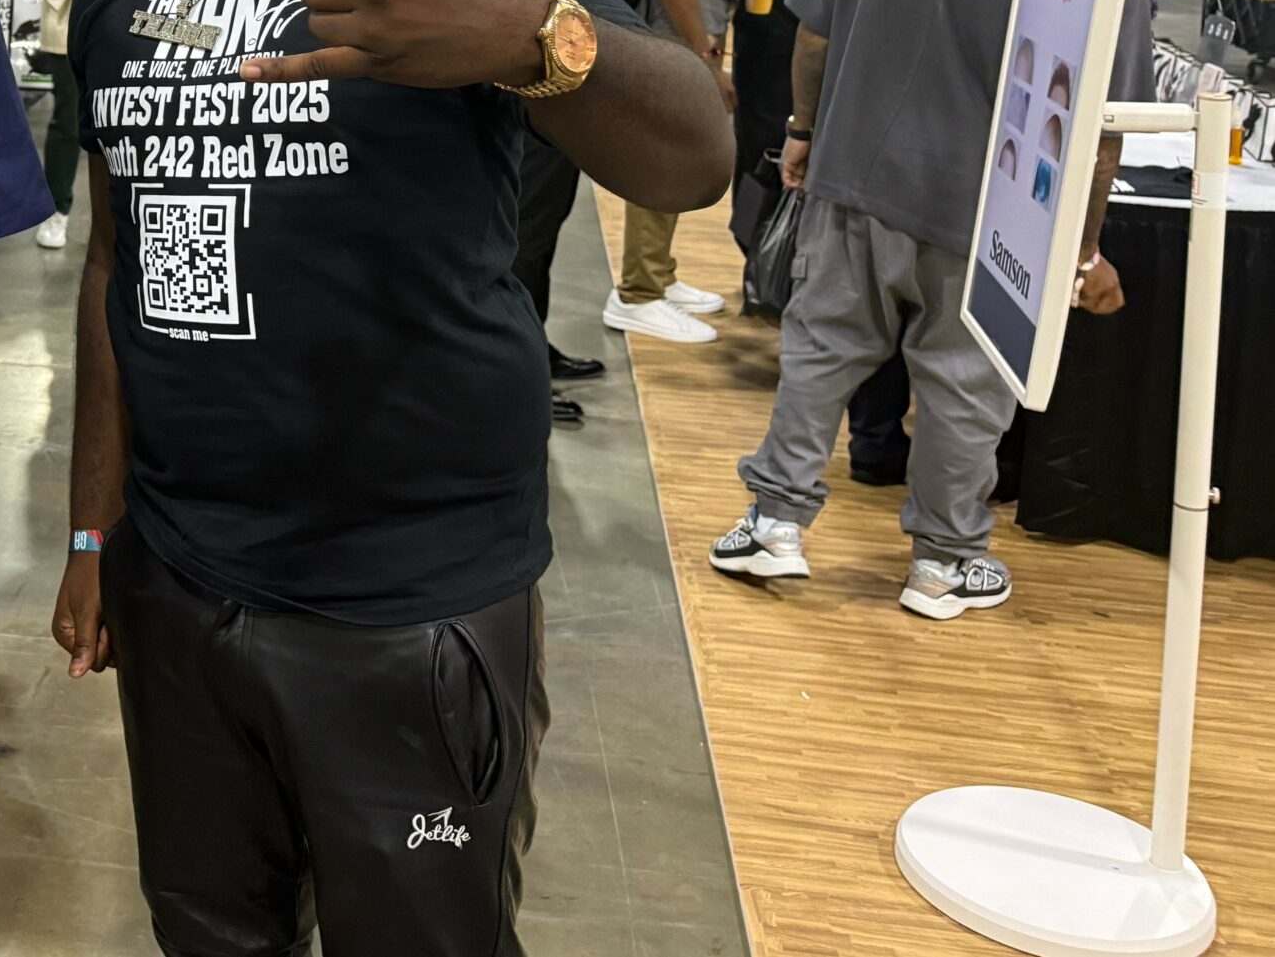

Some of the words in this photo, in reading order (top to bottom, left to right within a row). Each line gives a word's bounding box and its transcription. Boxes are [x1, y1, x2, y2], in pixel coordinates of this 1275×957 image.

[122, 59, 145, 80] ONE
[148, 60, 188, 81] VOICE,
[191, 58, 218, 78] ONE
[92, 86, 175, 129] INVEST
[176, 82, 246, 127] FEST
[252, 79, 331, 124] 2025
[143, 135, 195, 178] 242
[201, 135, 257, 178] Red
[263, 133, 350, 177] Zone
[989, 229, 1031, 301] Samson
[168, 327, 191, 342] scan
[192, 329, 209, 342] me
